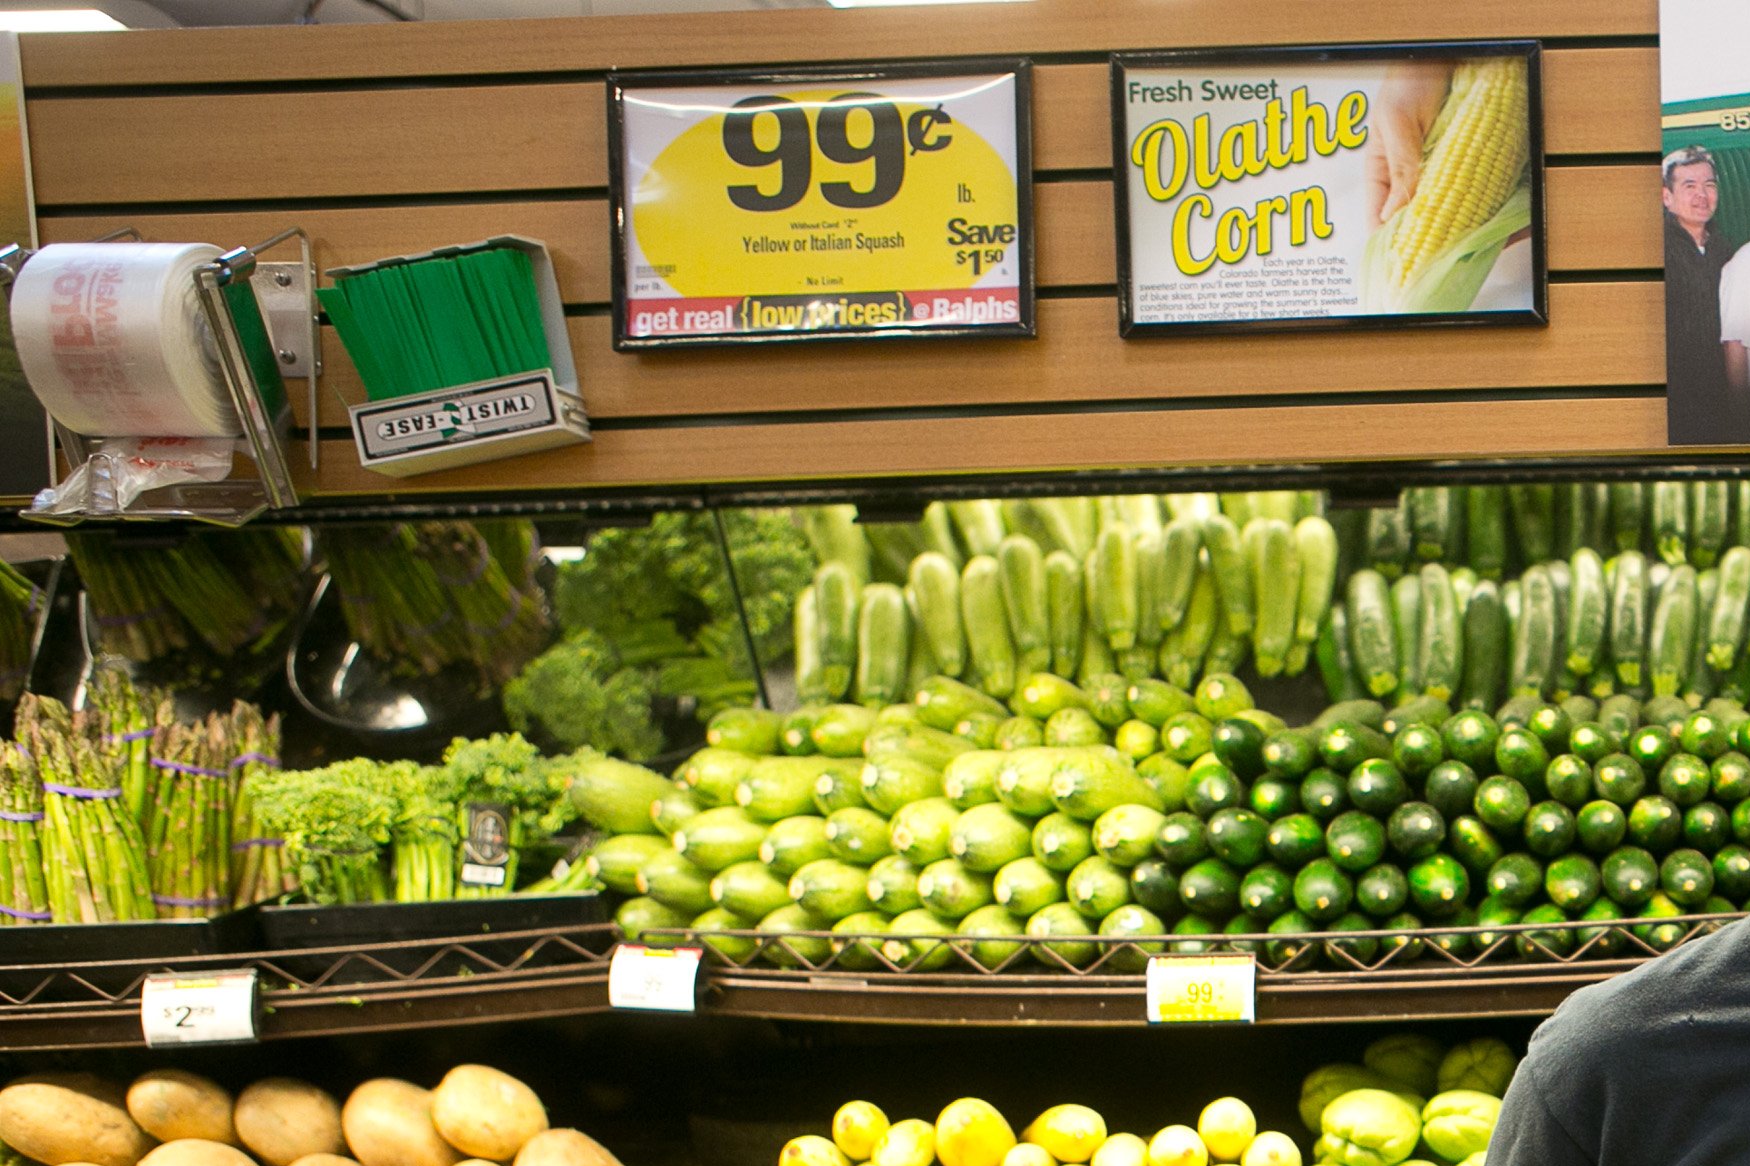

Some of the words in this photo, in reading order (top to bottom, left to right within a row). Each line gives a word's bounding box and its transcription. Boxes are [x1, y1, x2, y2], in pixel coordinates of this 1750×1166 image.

[1128, 80, 1193, 103] Fresh
[1202, 78, 1278, 101] Sweet
[723, 91, 953, 213] 99¢
[1131, 86, 1369, 203] Olathe
[957, 182, 975, 203] lb.
[742, 235, 790, 254] Yellow
[793, 239, 807, 252] or
[809, 233, 852, 251] Italian
[855, 231, 905, 254] Squash
[946, 217, 1016, 246] Save
[1171, 184, 1335, 277] Corn
[806, 276, 819, 286] No
[1140, 282, 1177, 291] sweetest
[1311, 278, 1325, 286] the
[1327, 276, 1353, 285] home
[1219, 268, 1259, 279] Colorado
[1261, 267, 1294, 277] farmers
[1296, 267, 1328, 276] harvest
[1330, 266, 1345, 275] the
[635, 306, 679, 336] get
[683, 304, 734, 330] real
[932, 295, 1018, 324] Ralphs
